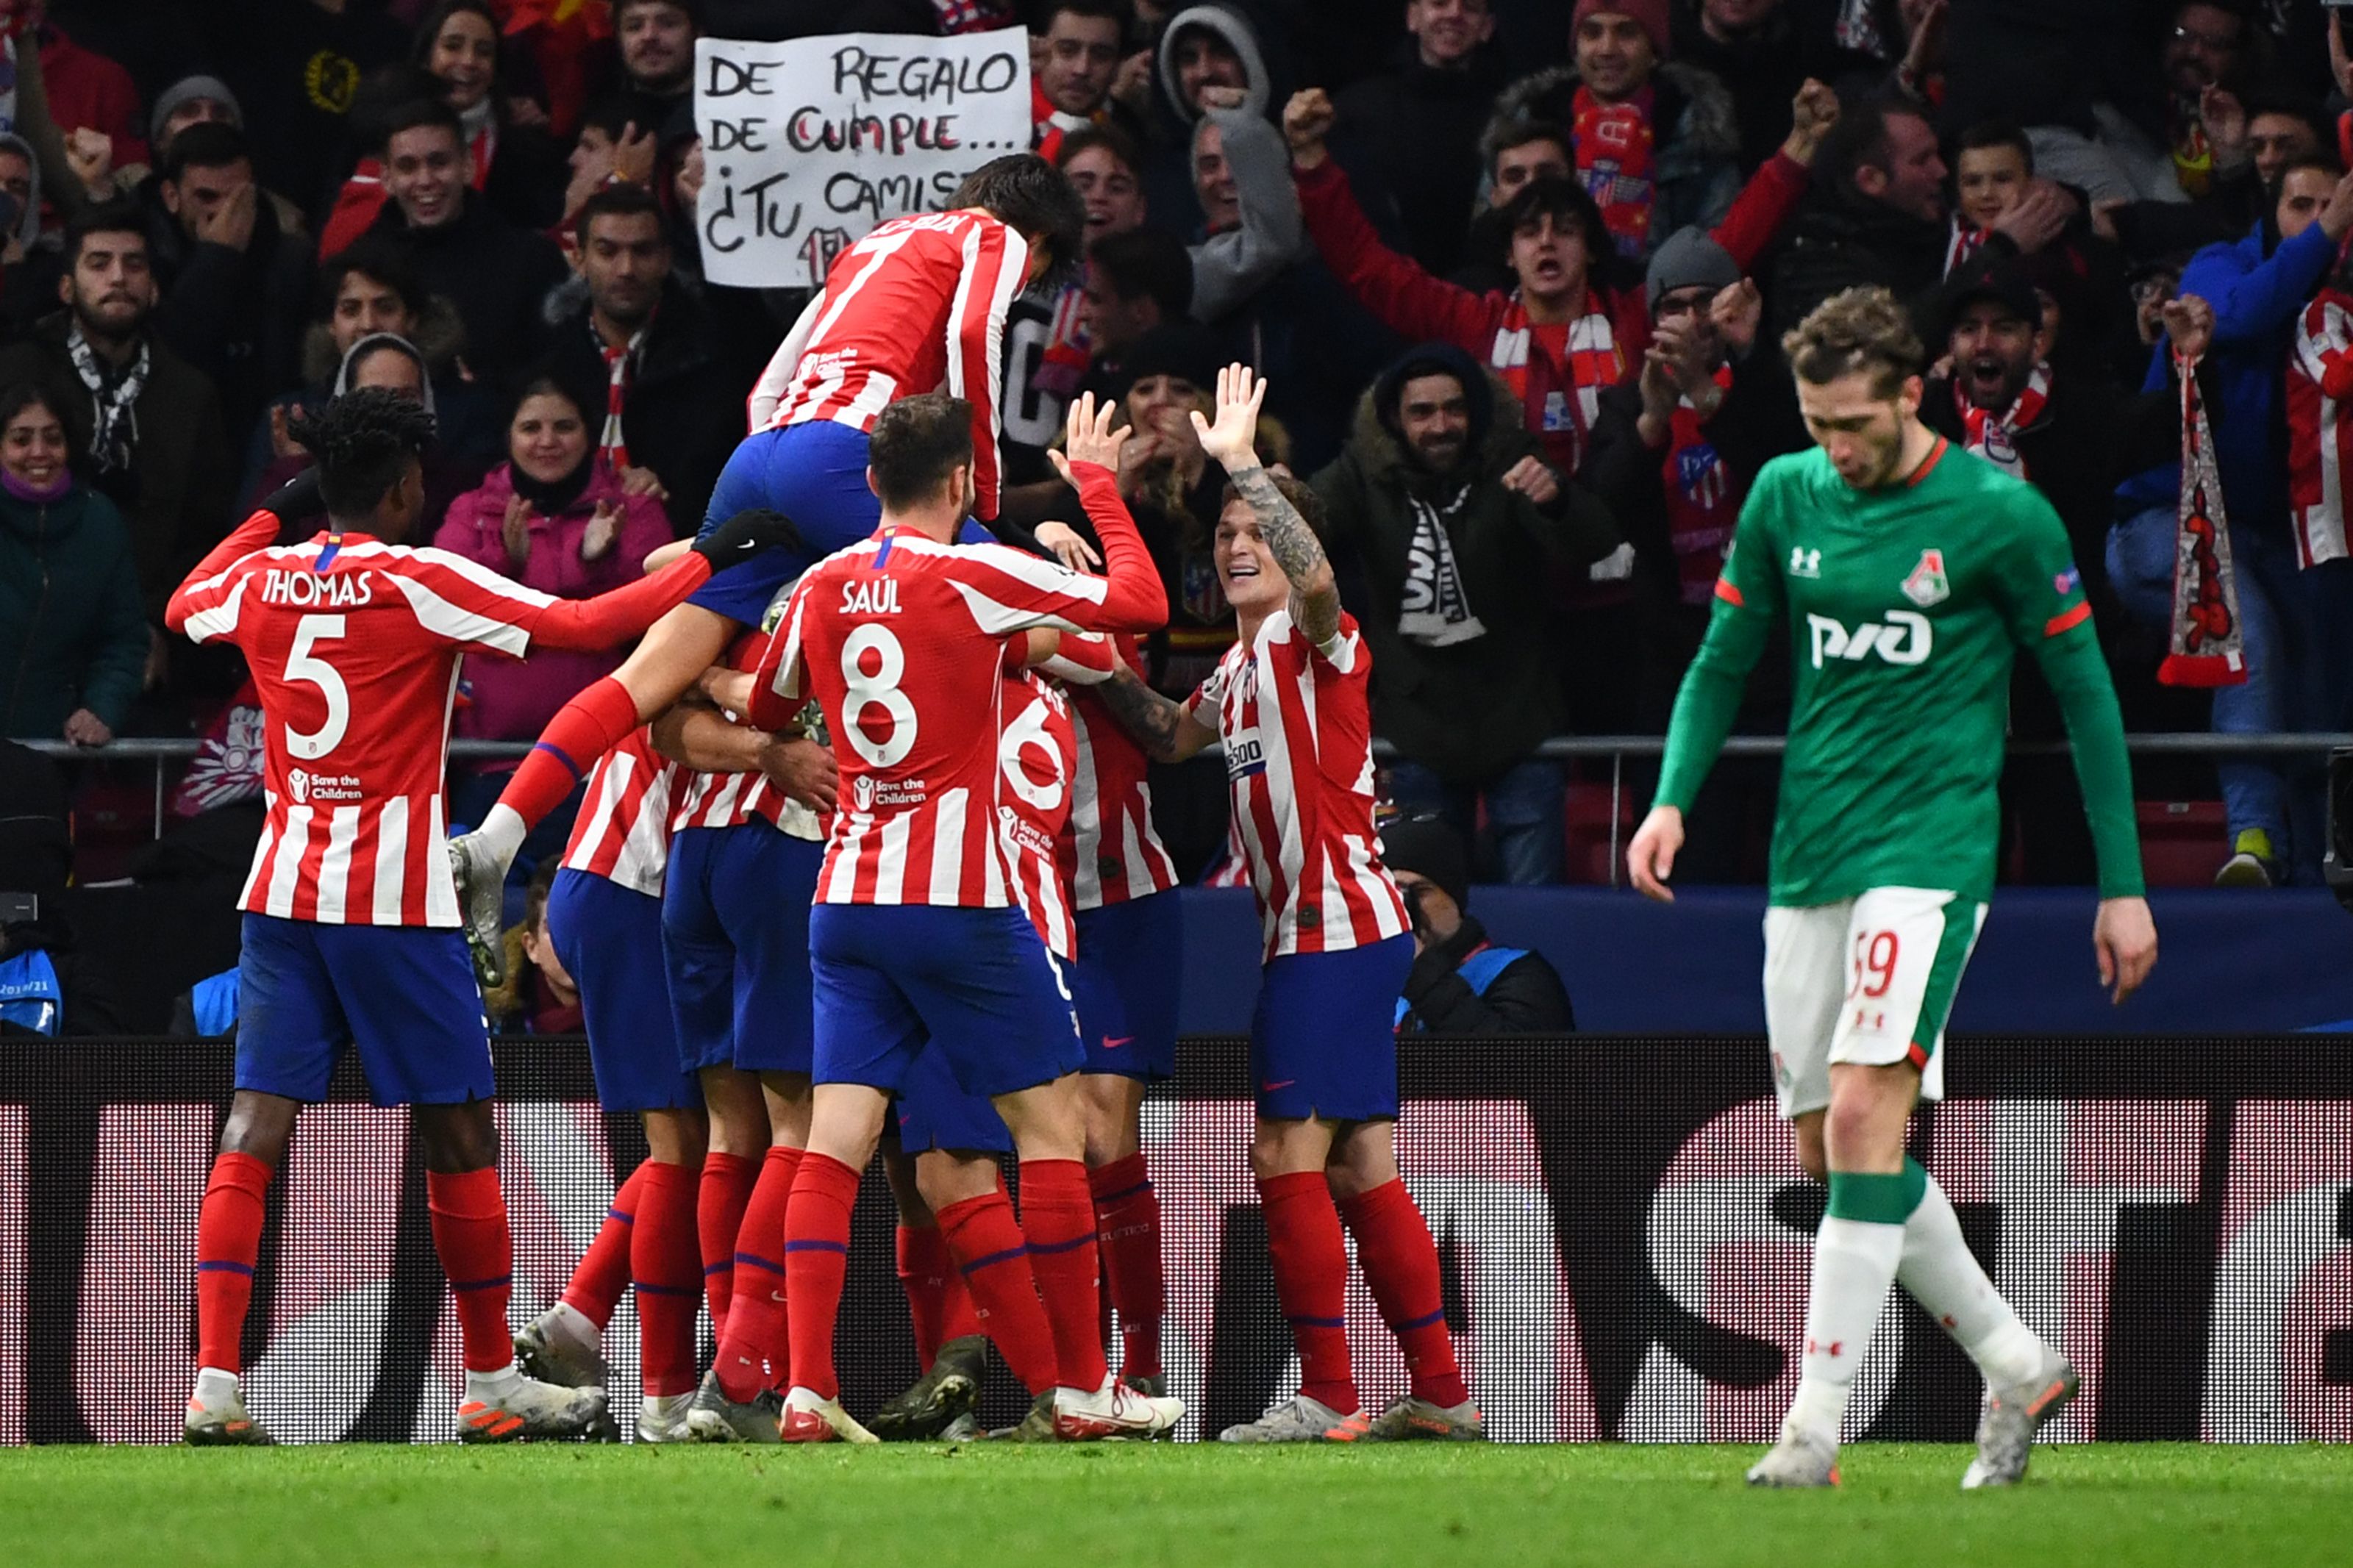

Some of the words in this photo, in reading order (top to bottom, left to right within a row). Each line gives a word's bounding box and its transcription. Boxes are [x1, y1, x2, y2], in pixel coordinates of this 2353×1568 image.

[704, 56, 785, 97] DE
[831, 46, 1017, 104] REGALO
[707, 118, 768, 151] DE
[824, 171, 972, 221] CAMIS
[804, 228, 915, 350] 7
[262, 569, 372, 606] THOMAS
[839, 574, 902, 613] SAÚL
[283, 615, 349, 759] 5
[841, 623, 918, 767] 8
[1000, 697, 1065, 810] 6
[311, 775, 338, 787] Save
[340, 775, 360, 787] the
[312, 787, 362, 799] Children
[876, 780, 901, 792] Save
[903, 778, 925, 790] the
[876, 791, 926, 805] Children
[1018, 820, 1040, 840] Save
